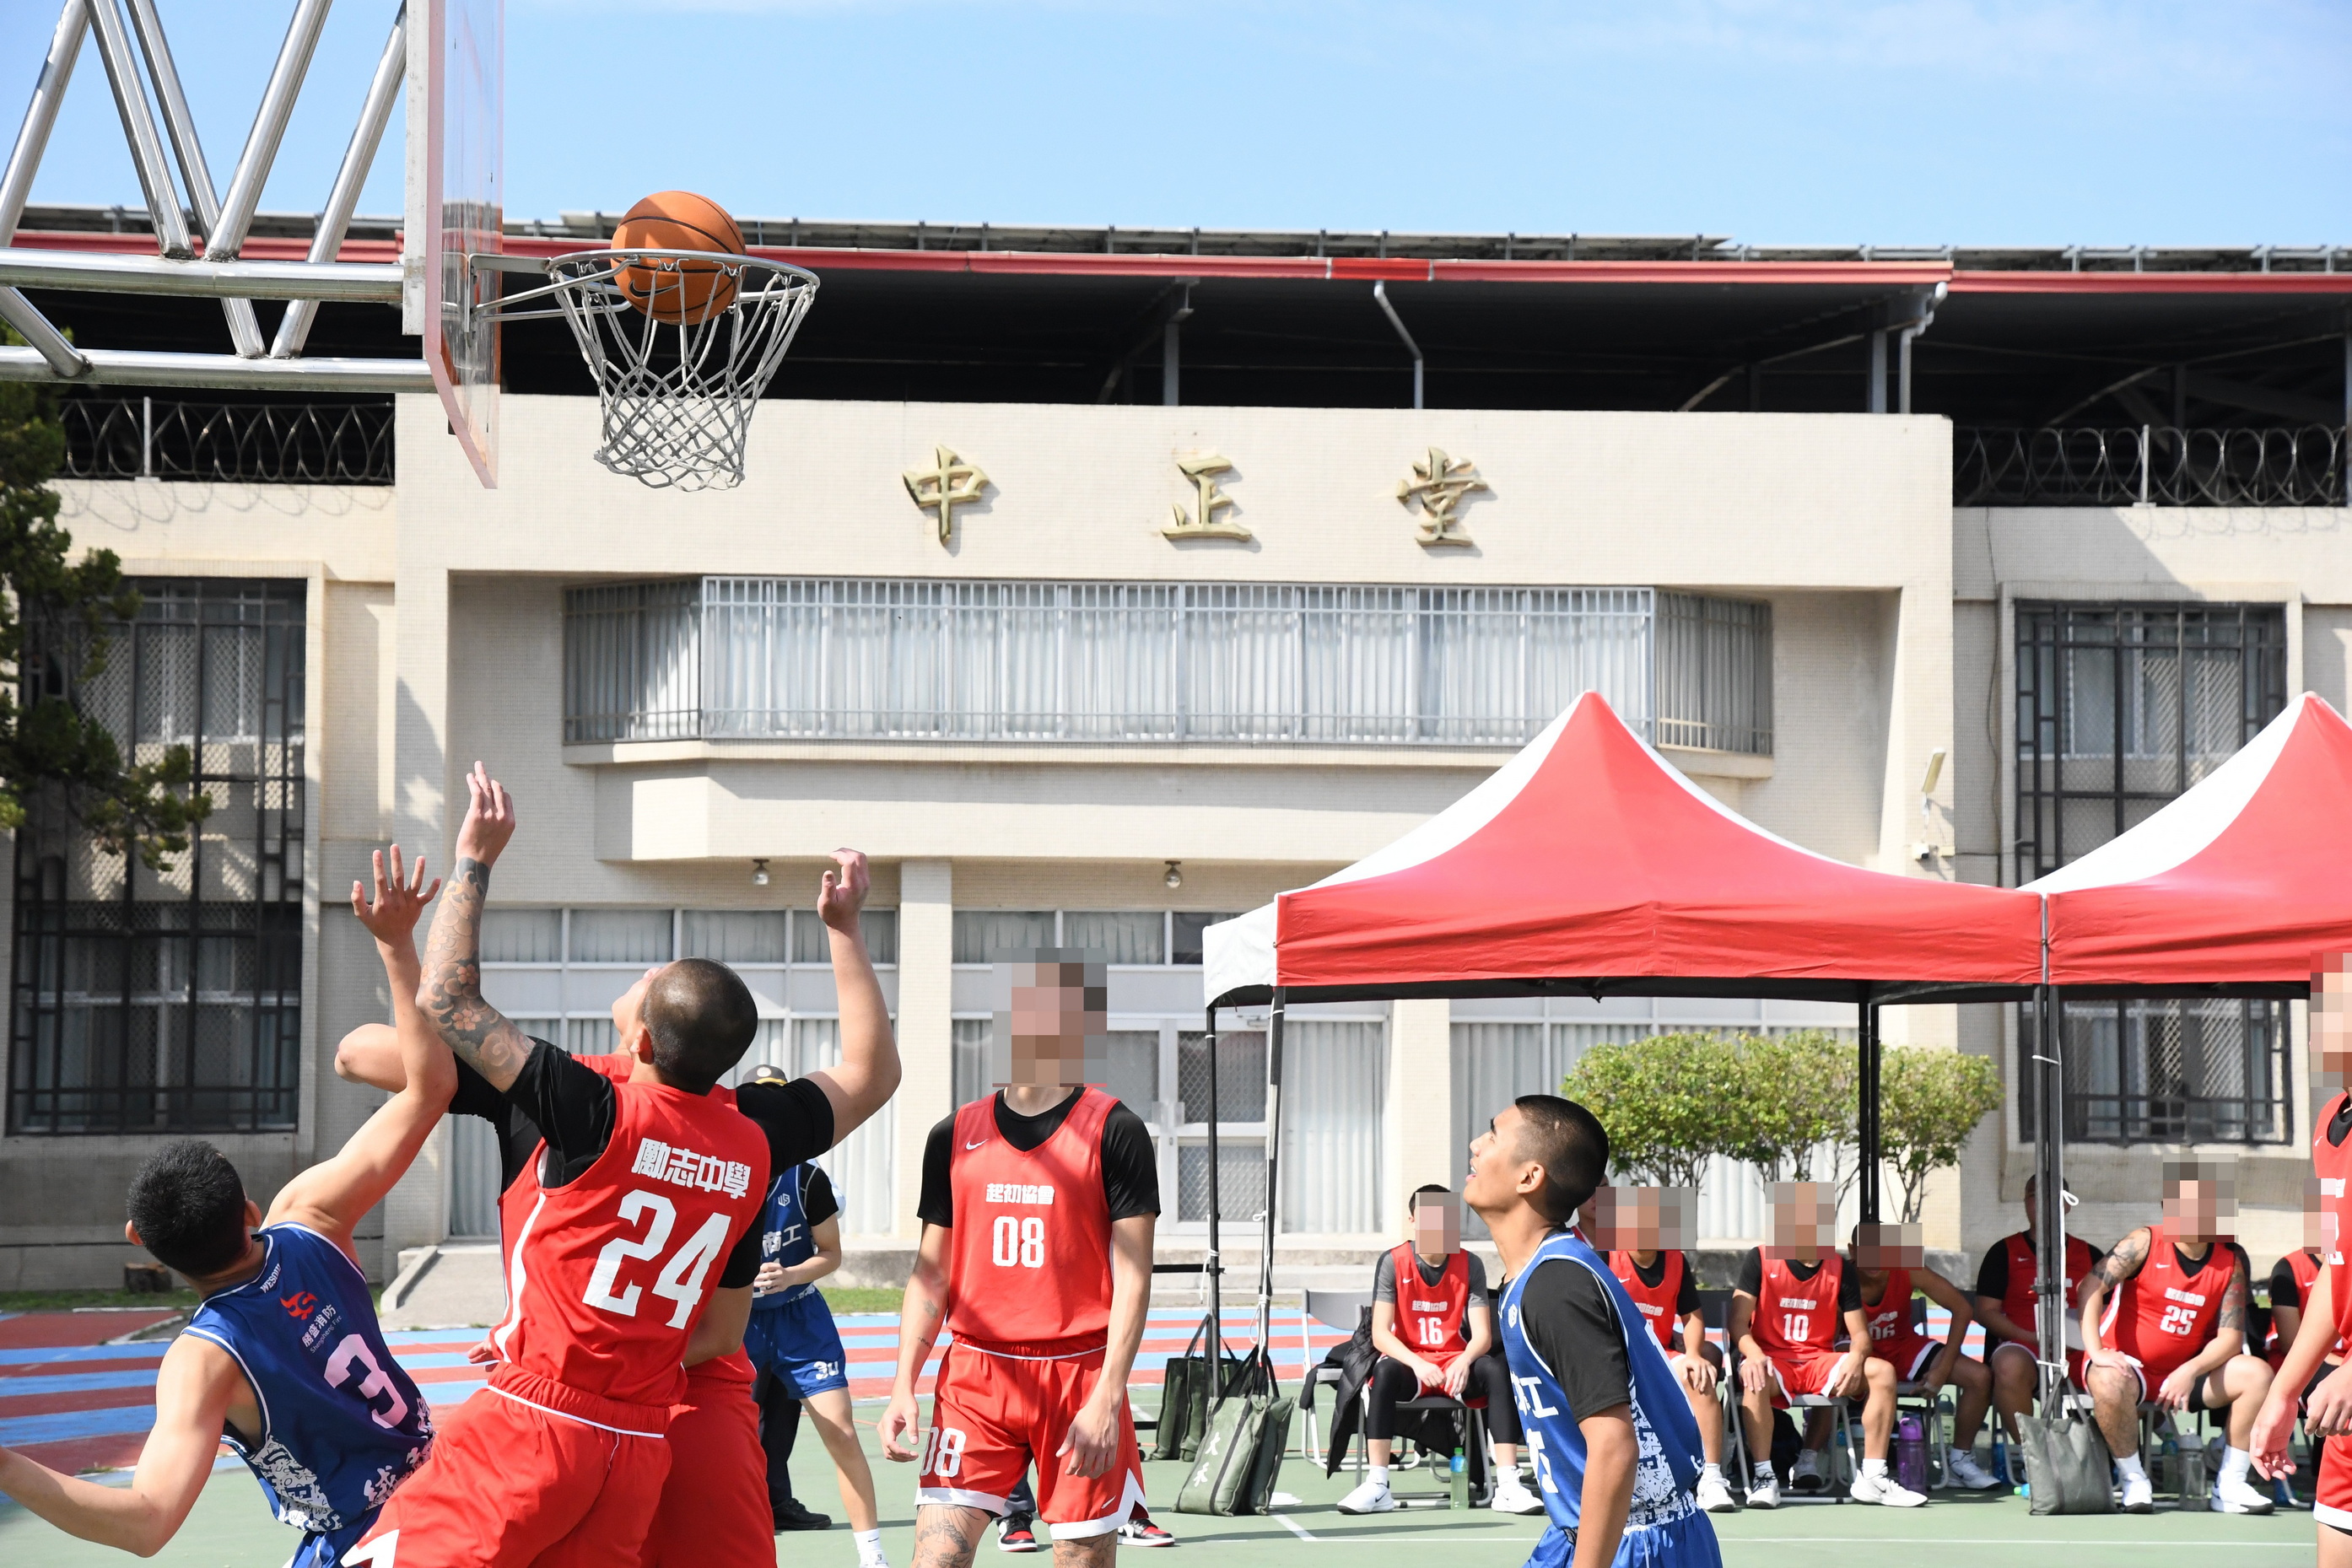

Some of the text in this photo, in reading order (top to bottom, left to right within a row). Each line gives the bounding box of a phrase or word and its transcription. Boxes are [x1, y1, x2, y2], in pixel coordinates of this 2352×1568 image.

[902, 444, 1490, 547] 中正堂
[631, 1137, 752, 1199] 勵志中學
[985, 1183, 1055, 1205] 起初協會
[581, 1188, 732, 1330] 24
[992, 1215, 1045, 1269] 08
[1417, 1317, 1443, 1345] 16
[1783, 1313, 1809, 1342] 10
[2160, 1305, 2198, 1336] 25
[323, 1333, 408, 1430] 3
